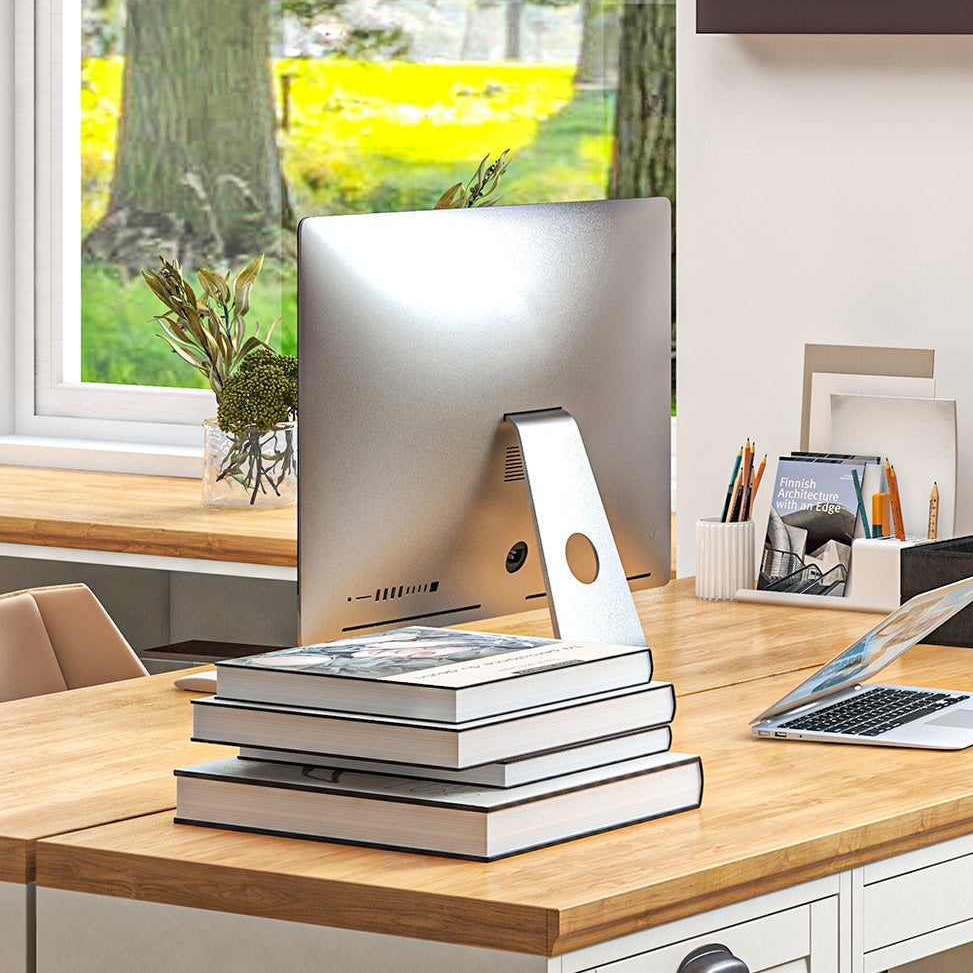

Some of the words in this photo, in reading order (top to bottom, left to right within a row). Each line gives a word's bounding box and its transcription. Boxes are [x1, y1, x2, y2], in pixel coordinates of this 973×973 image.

[780, 477, 816, 489] Finnish
[777, 488, 839, 502] Architecture
[776, 500, 798, 510] with
[800, 503, 813, 511] an
[815, 502, 841, 515] Edge
